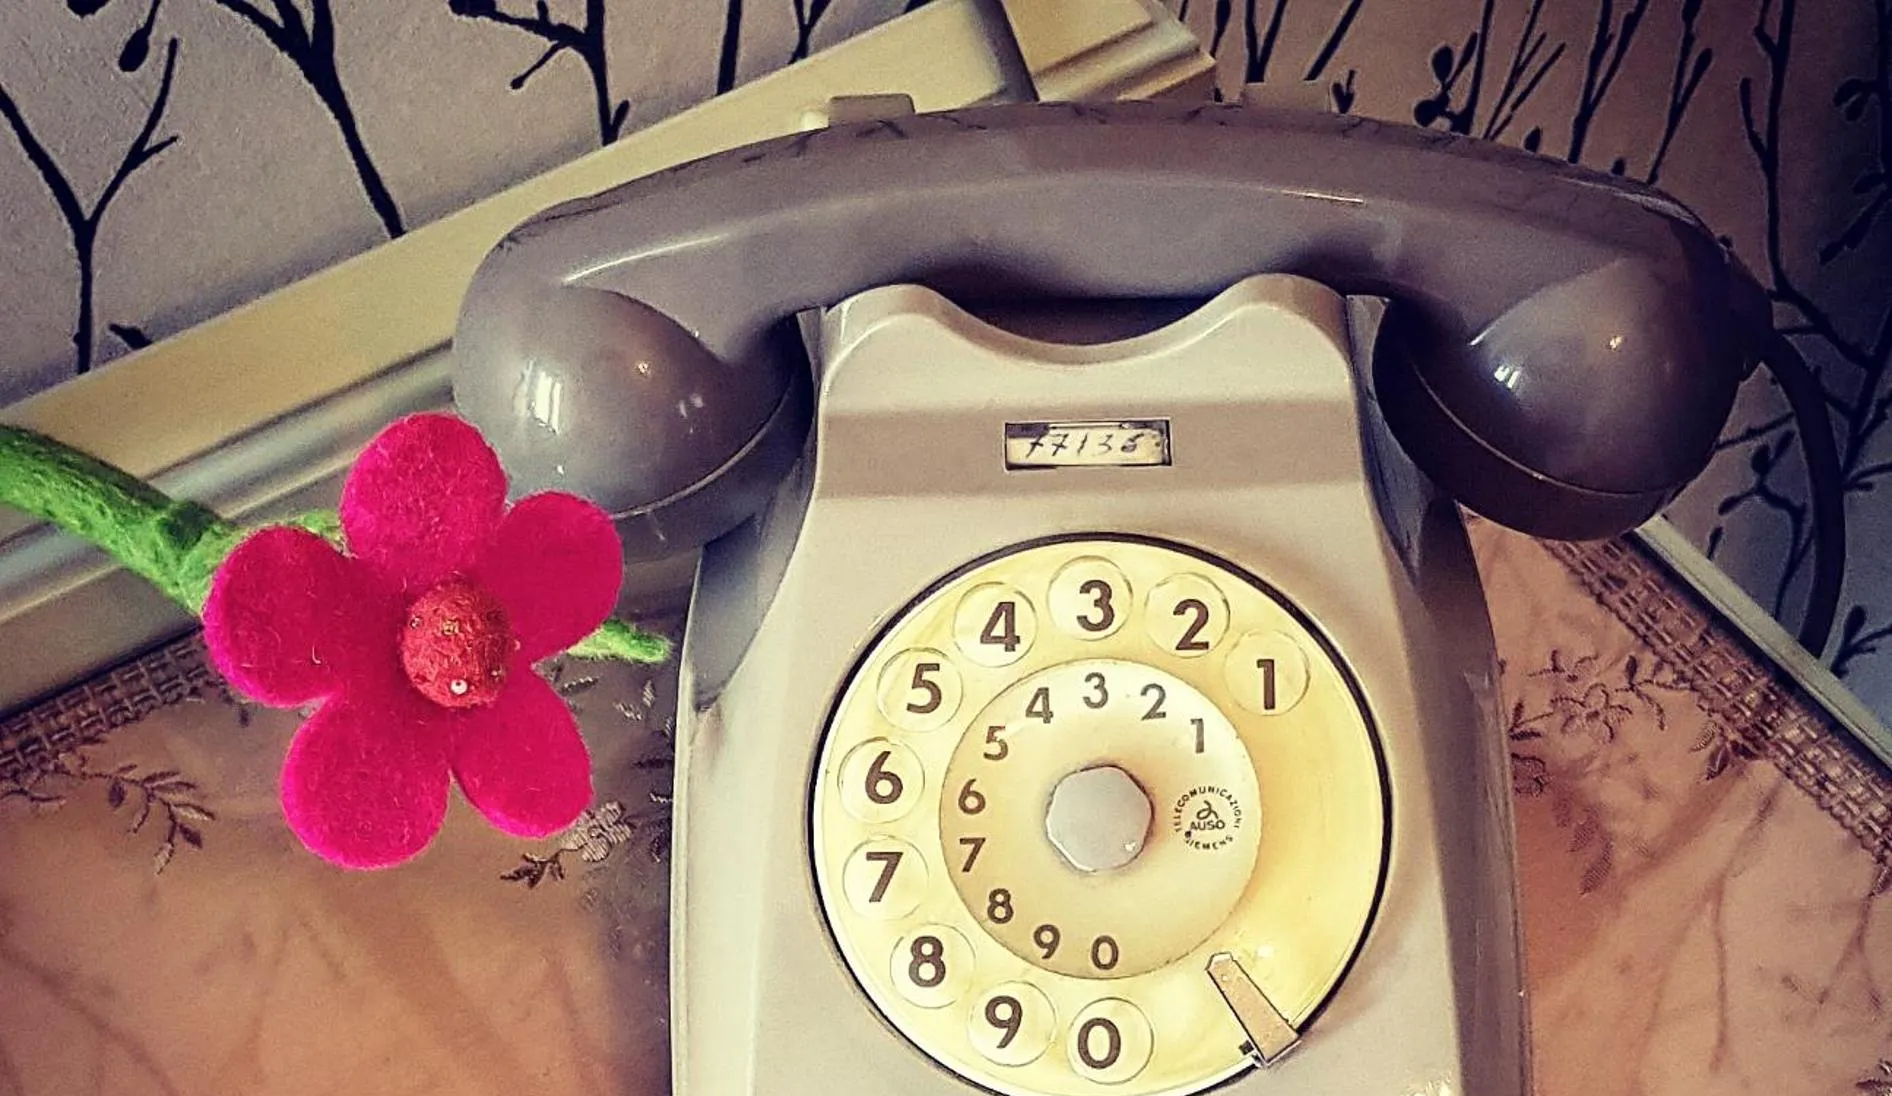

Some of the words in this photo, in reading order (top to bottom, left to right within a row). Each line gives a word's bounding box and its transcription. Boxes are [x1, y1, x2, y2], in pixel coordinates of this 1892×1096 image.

[1076, 580, 1114, 632] 3
[1174, 599, 1209, 650] 2
[980, 601, 1020, 652] 4
[906, 663, 942, 714] 5
[1083, 673, 1109, 709] 3
[1140, 684, 1166, 721] 2
[1256, 659, 1276, 709] 1
[1025, 687, 1053, 723] 4
[983, 726, 1008, 761] 5
[1190, 718, 1204, 753] 1
[864, 751, 903, 804] 6
[958, 778, 986, 815] 6
[1190, 819, 1225, 831] AUSO
[959, 838, 985, 872] 7
[865, 852, 903, 902] 7
[987, 889, 1013, 924] 8
[1033, 925, 1061, 959] 9
[1091, 936, 1119, 970] 0
[908, 936, 946, 987] 8
[985, 996, 1022, 1049] 9
[1077, 1018, 1121, 1069] 0
